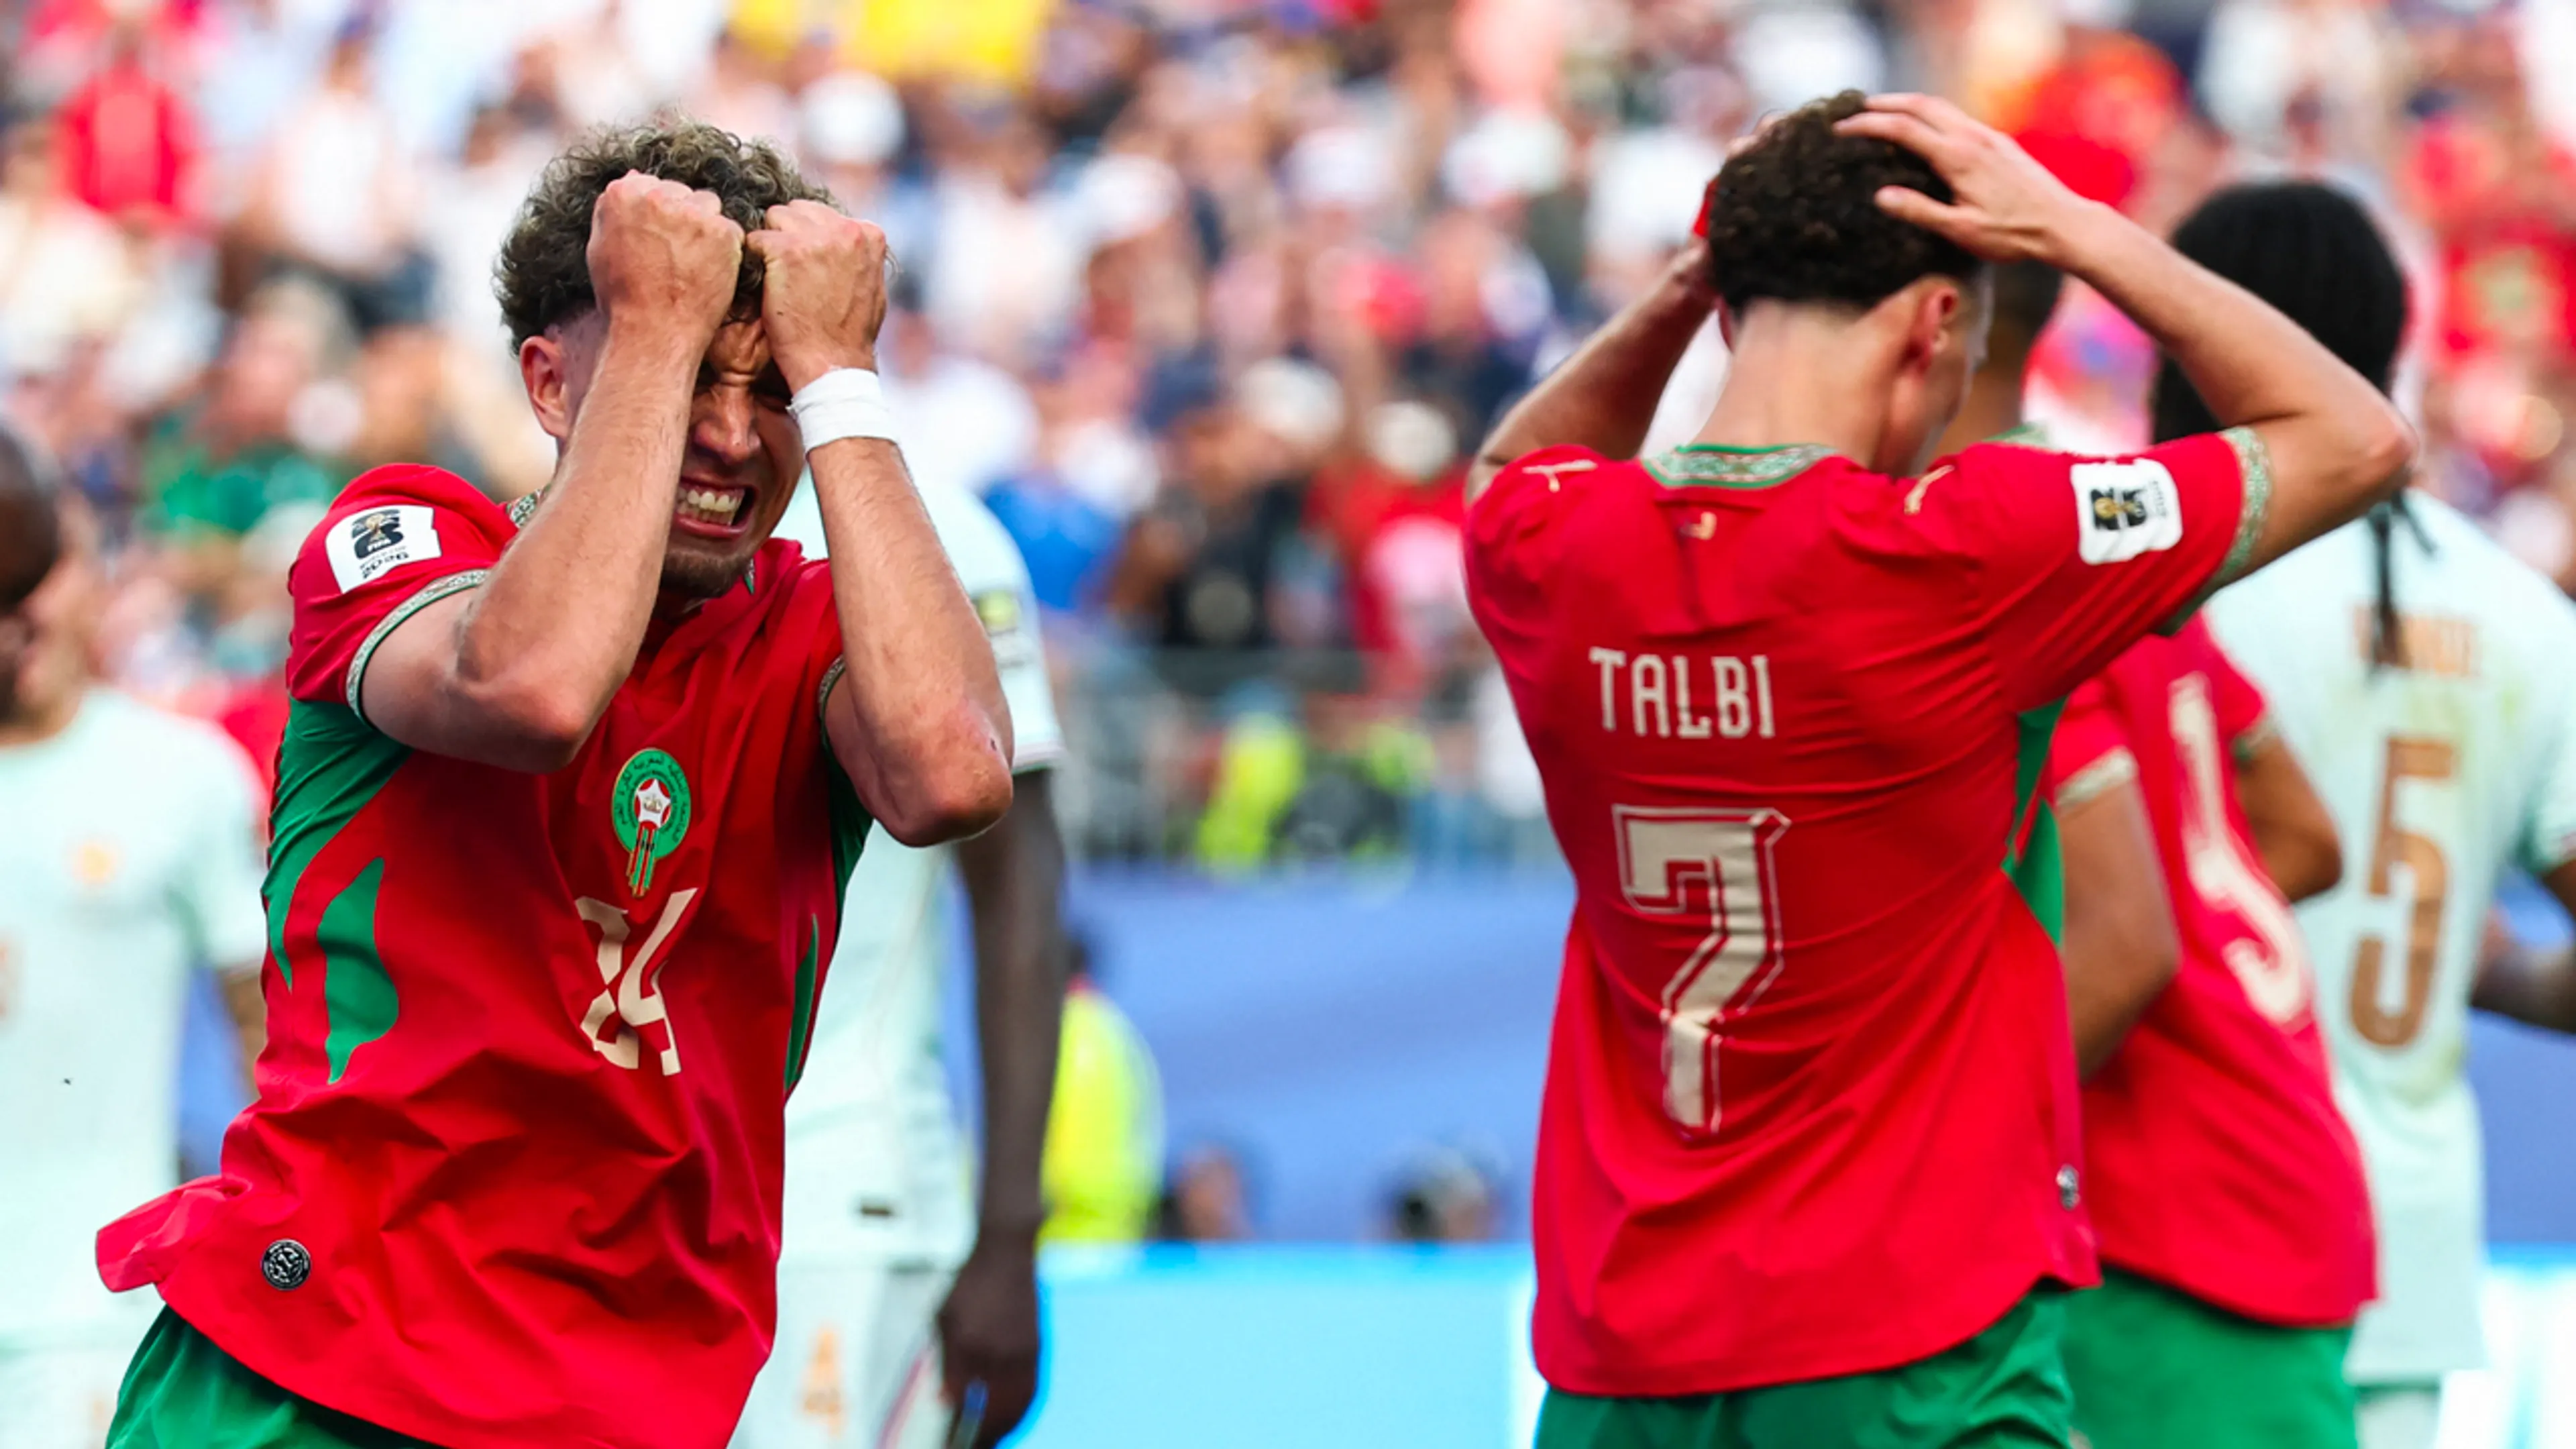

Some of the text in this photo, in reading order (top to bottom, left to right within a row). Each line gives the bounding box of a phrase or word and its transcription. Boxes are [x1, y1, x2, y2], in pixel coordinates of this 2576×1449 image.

[1589, 646, 1776, 739] TALBI
[1611, 803, 1792, 1136] 7
[2350, 735, 2455, 1049] 5
